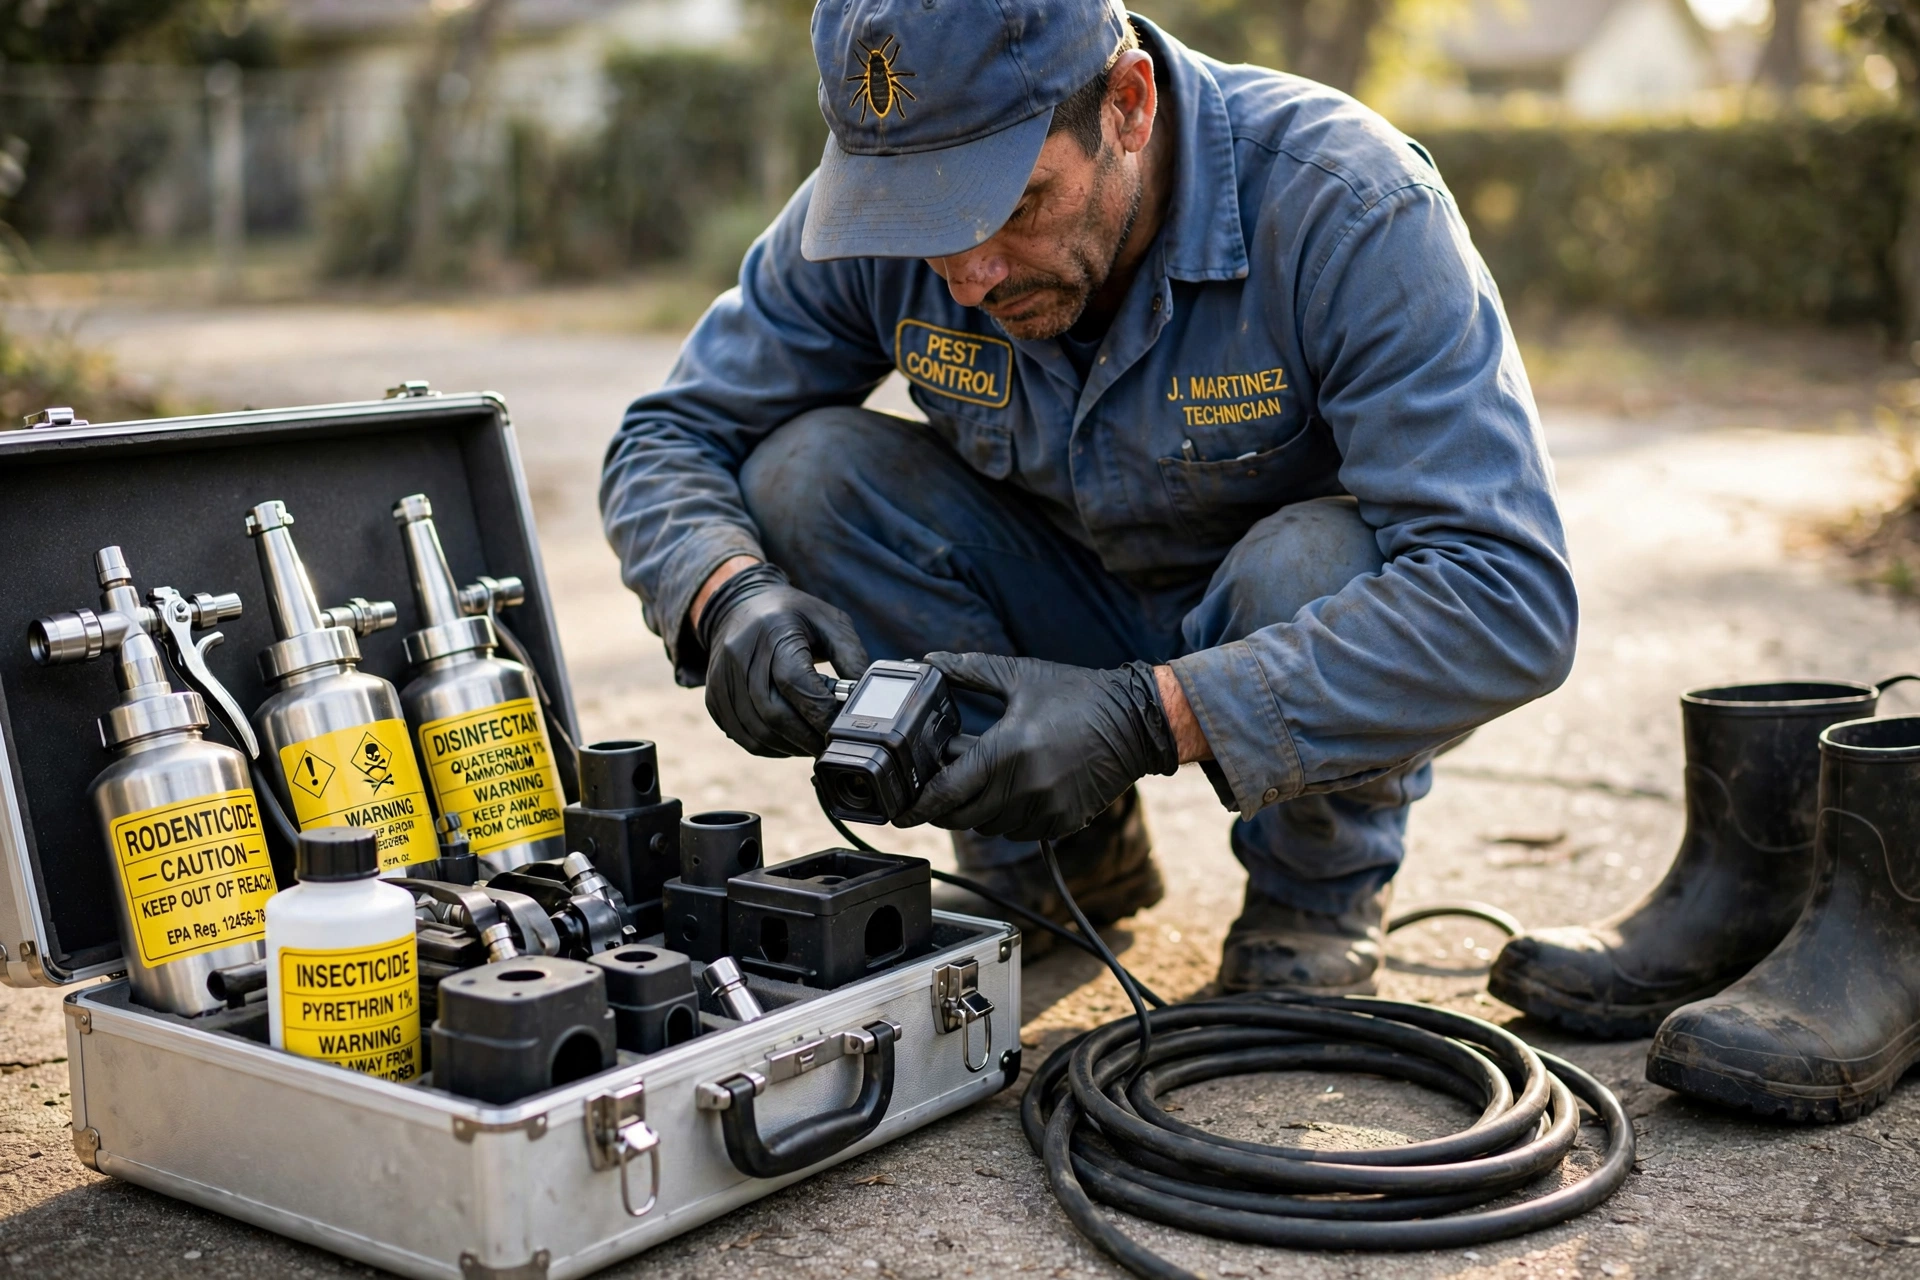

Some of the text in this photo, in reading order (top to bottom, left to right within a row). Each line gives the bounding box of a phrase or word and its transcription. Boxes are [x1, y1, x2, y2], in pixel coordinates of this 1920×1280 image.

[927, 333, 982, 367] PEST
[906, 352, 999, 397] CONTROL
[1167, 368, 1288, 401] J. MARTINEZ
[1182, 397, 1282, 426] TECHNICIAN
[465, 755, 535, 785] AMMONIUM
[473, 773, 544, 803] WARNING
[344, 797, 414, 828] WARNING
[466, 808, 560, 841] FROM CHILDREN
[472, 795, 540, 823] KEEP AWAY
[124, 803, 256, 857] RODENTICIDE
[160, 842, 248, 883] CAUTION
[141, 873, 273, 919] KEEP OUT OF REACH
[167, 926, 192, 946] EPA
[193, 922, 221, 938] Reg.
[296, 950, 410, 989] INSECTICIDE
[302, 993, 394, 1022] PYRETHRIN
[318, 1025, 402, 1055] WARNING
[348, 1046, 413, 1073] AWAY FROM
